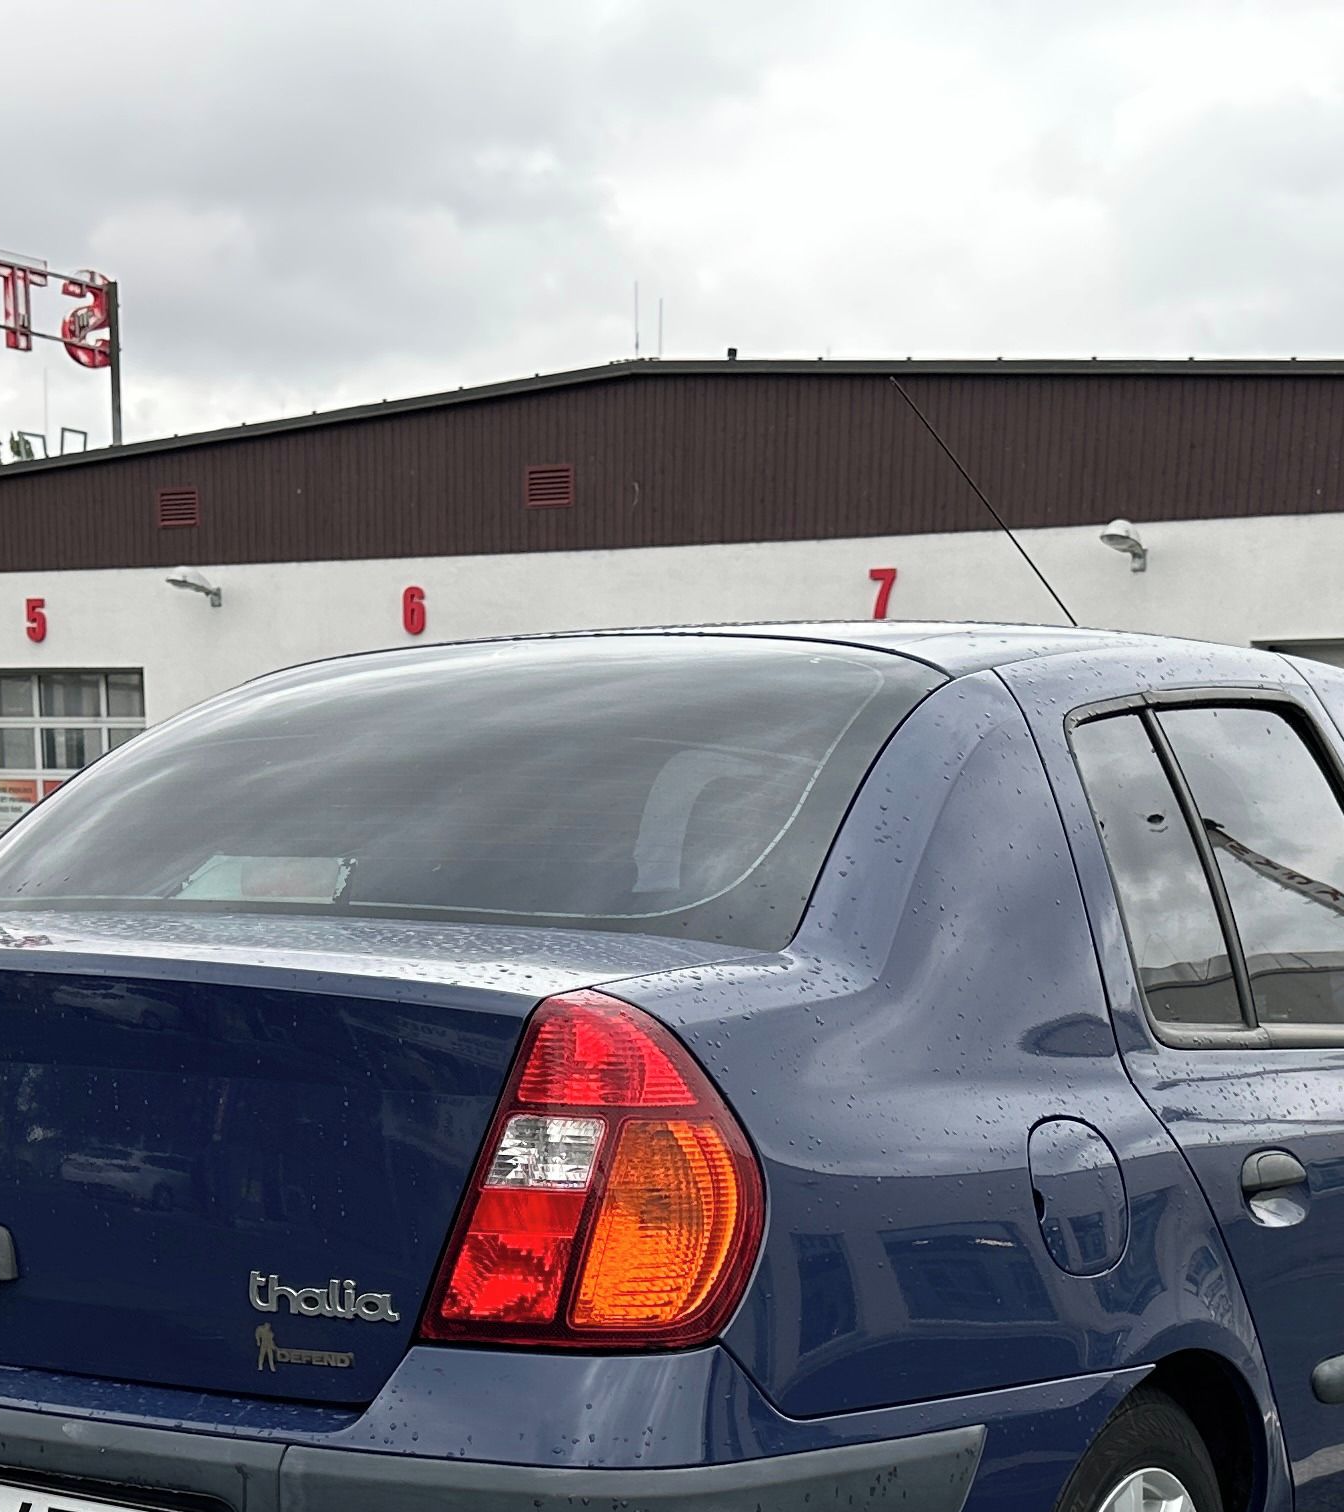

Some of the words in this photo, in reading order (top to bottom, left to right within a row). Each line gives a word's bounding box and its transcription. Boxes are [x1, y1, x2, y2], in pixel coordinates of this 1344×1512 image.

[402, 585, 427, 636] 6
[867, 567, 898, 620] 7
[26, 597, 48, 643] 5
[249, 1270, 400, 1322] thalia
